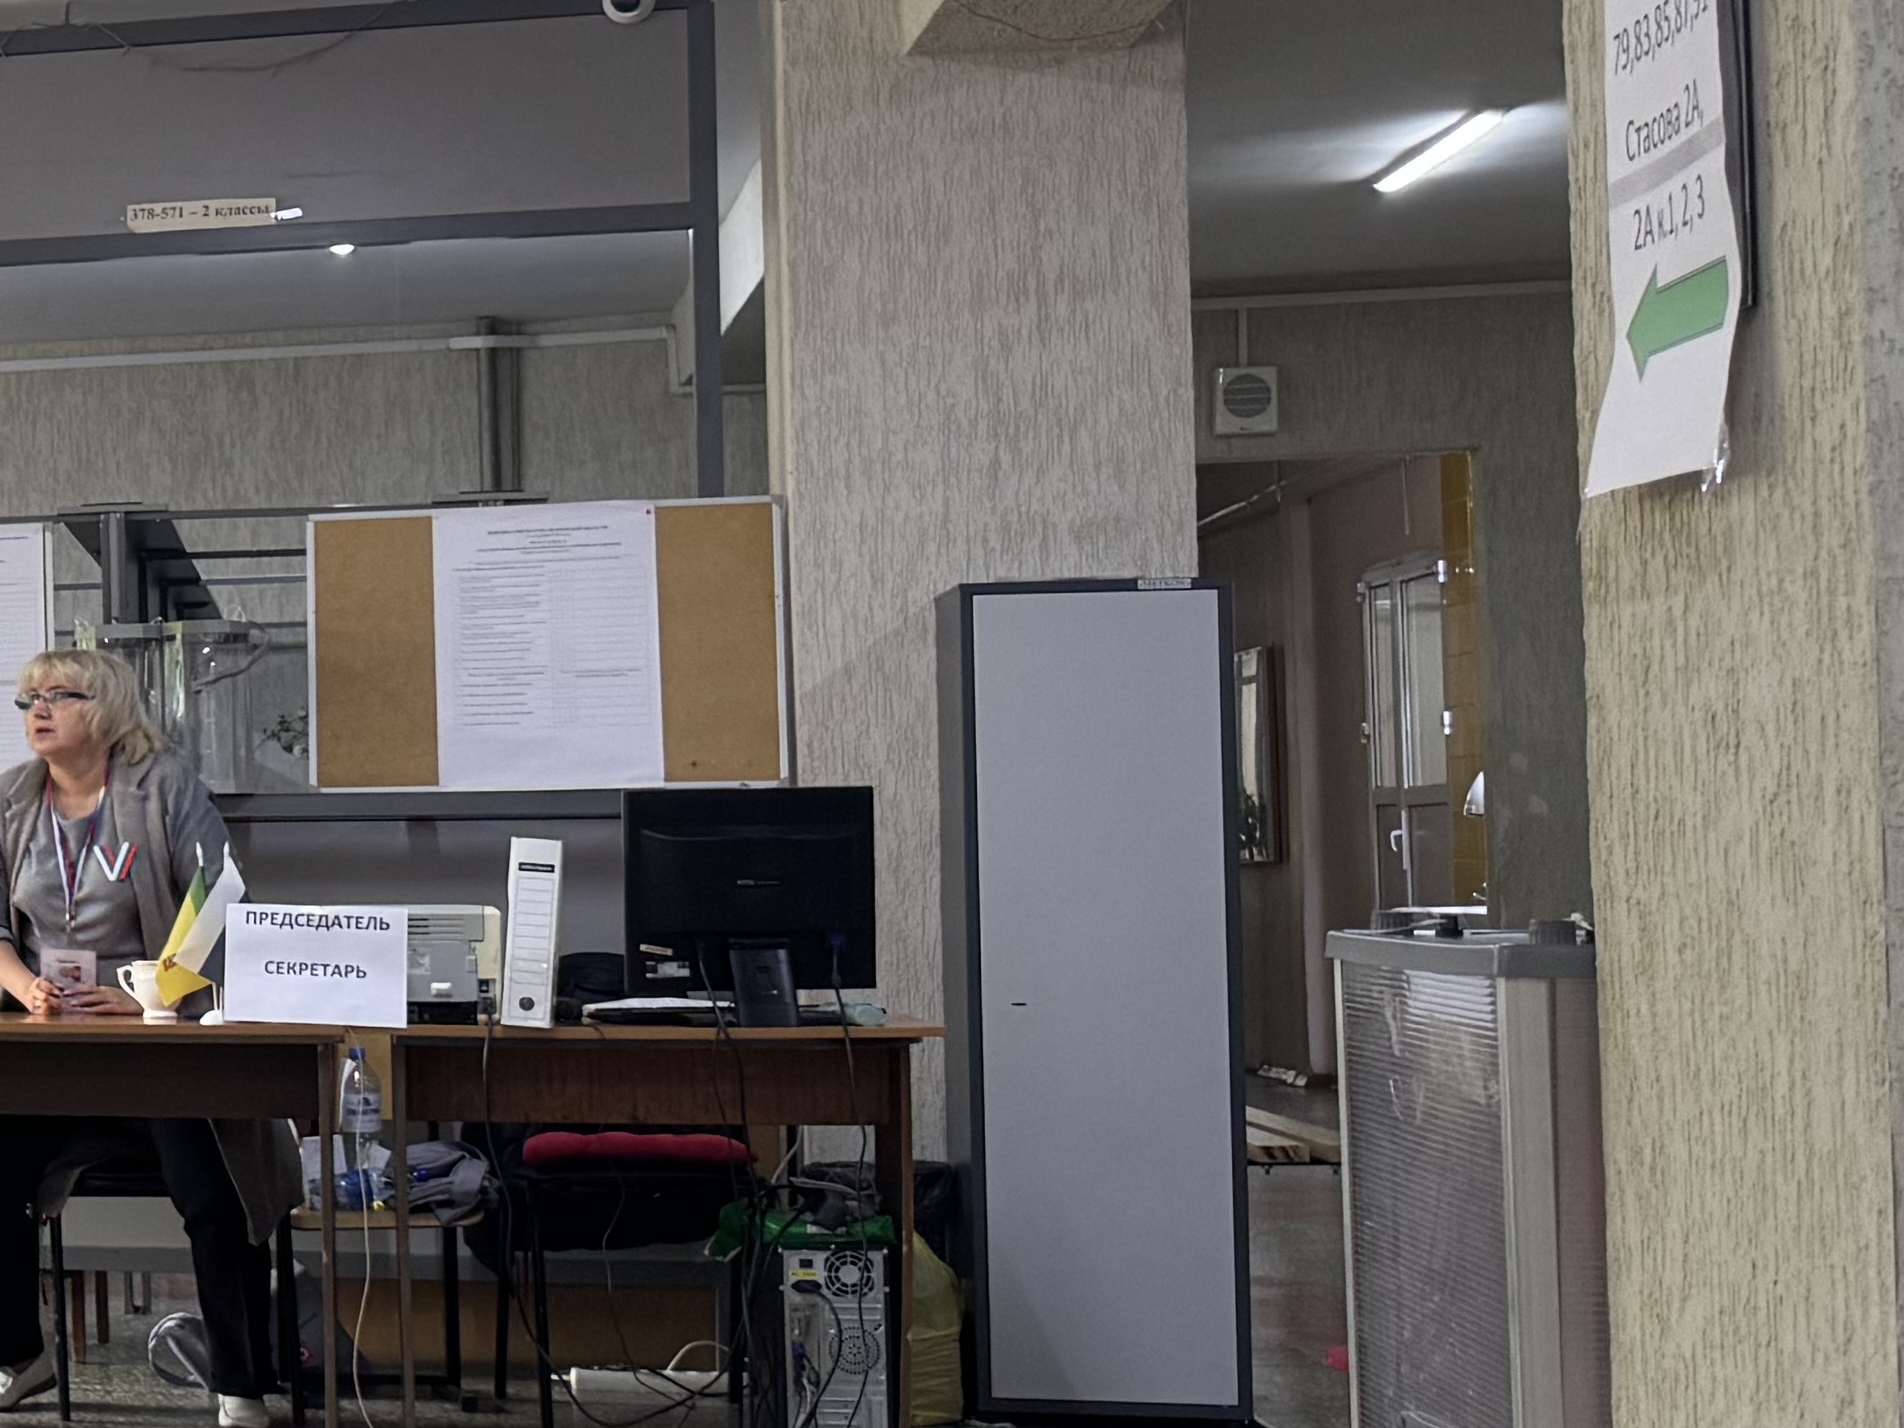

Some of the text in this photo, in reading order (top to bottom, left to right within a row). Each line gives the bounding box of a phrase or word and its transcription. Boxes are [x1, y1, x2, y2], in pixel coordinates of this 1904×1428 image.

[1625, 102, 1681, 162] Стасова
[129, 205, 184, 221] 378-571
[201, 204, 210, 217] 2
[214, 204, 270, 220] классы
[245, 910, 391, 932] ПРЕДСЕДАТЕЛЬ
[264, 960, 368, 979] СЕКРЕТАРЬ
